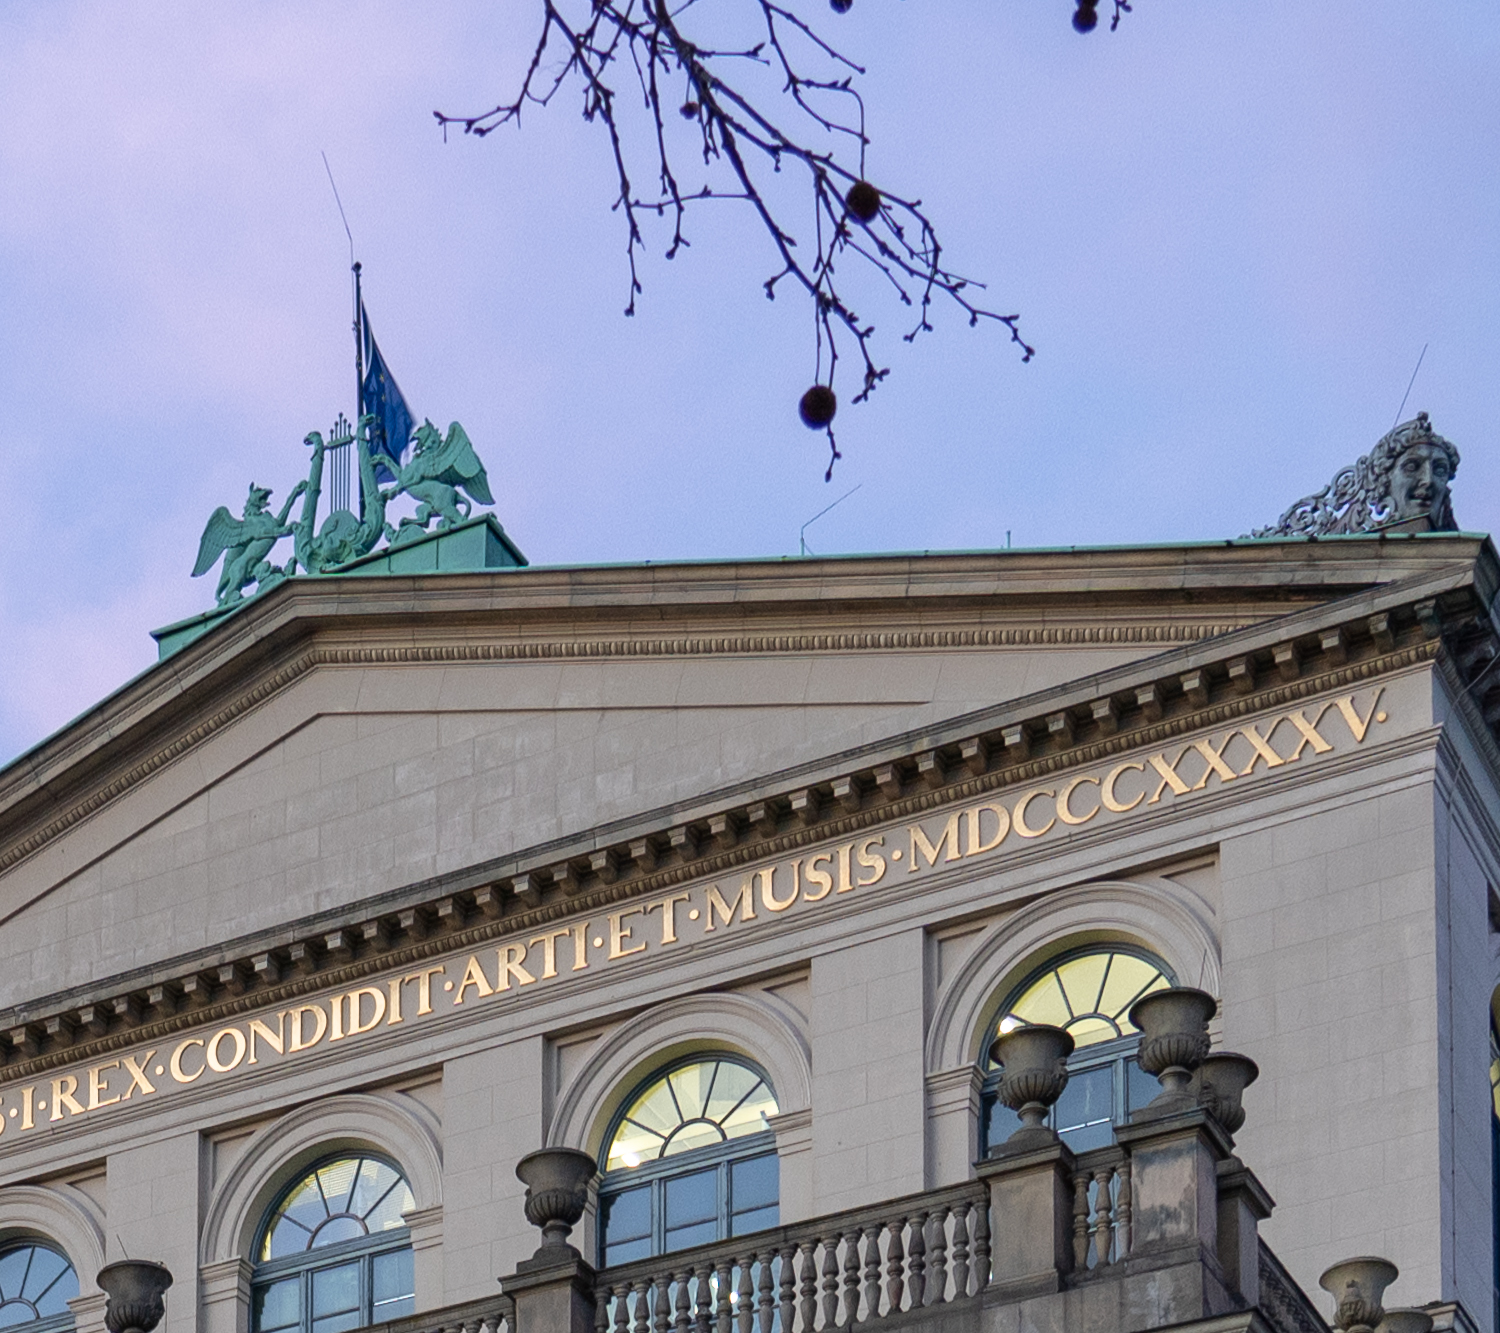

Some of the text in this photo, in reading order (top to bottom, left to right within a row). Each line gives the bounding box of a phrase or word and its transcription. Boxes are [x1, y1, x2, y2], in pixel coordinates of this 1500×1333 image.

[20, 1085, 38, 1131] I
[49, 1055, 158, 1121] REX
[170, 966, 446, 1084] CONDIDIT
[453, 922, 589, 1005] ARTI
[608, 893, 691, 962] ET
[703, 836, 889, 932] MUSIS
